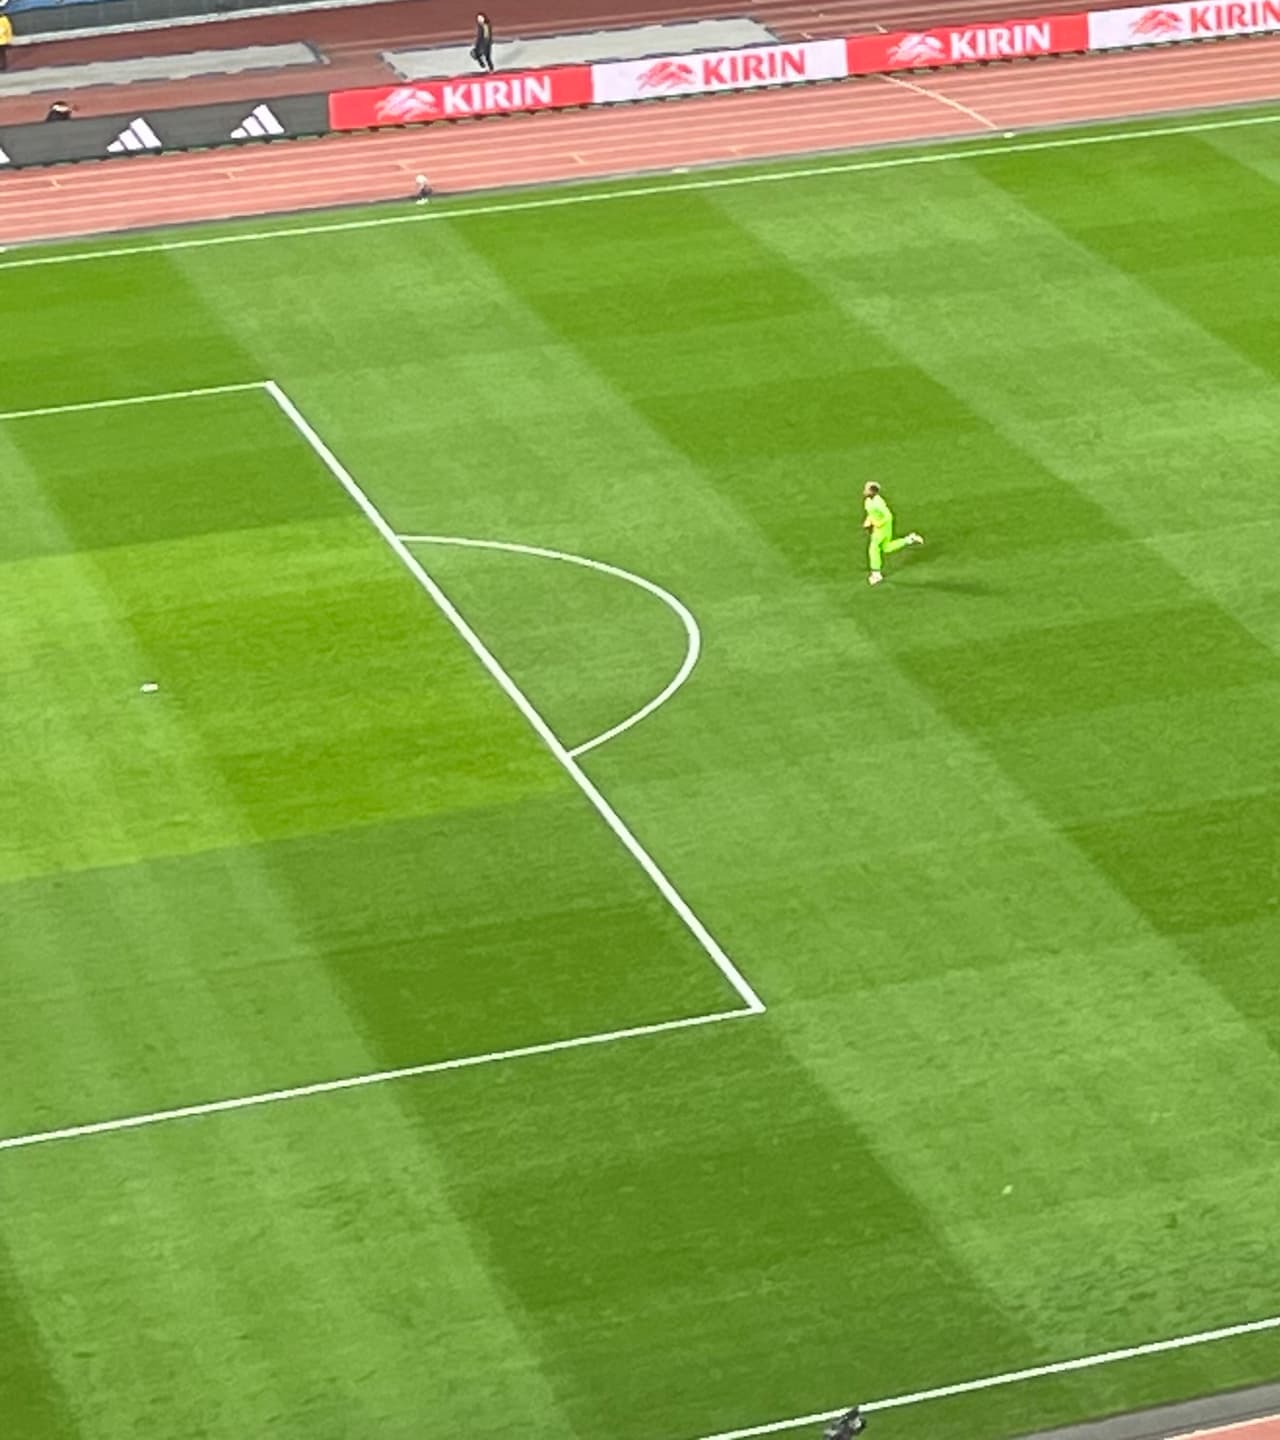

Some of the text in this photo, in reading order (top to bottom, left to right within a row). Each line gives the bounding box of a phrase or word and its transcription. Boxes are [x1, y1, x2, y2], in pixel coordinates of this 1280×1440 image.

[951, 21, 1051, 59] KIRIN
[703, 48, 806, 85] KIRIN
[443, 74, 552, 116] KIRIN
